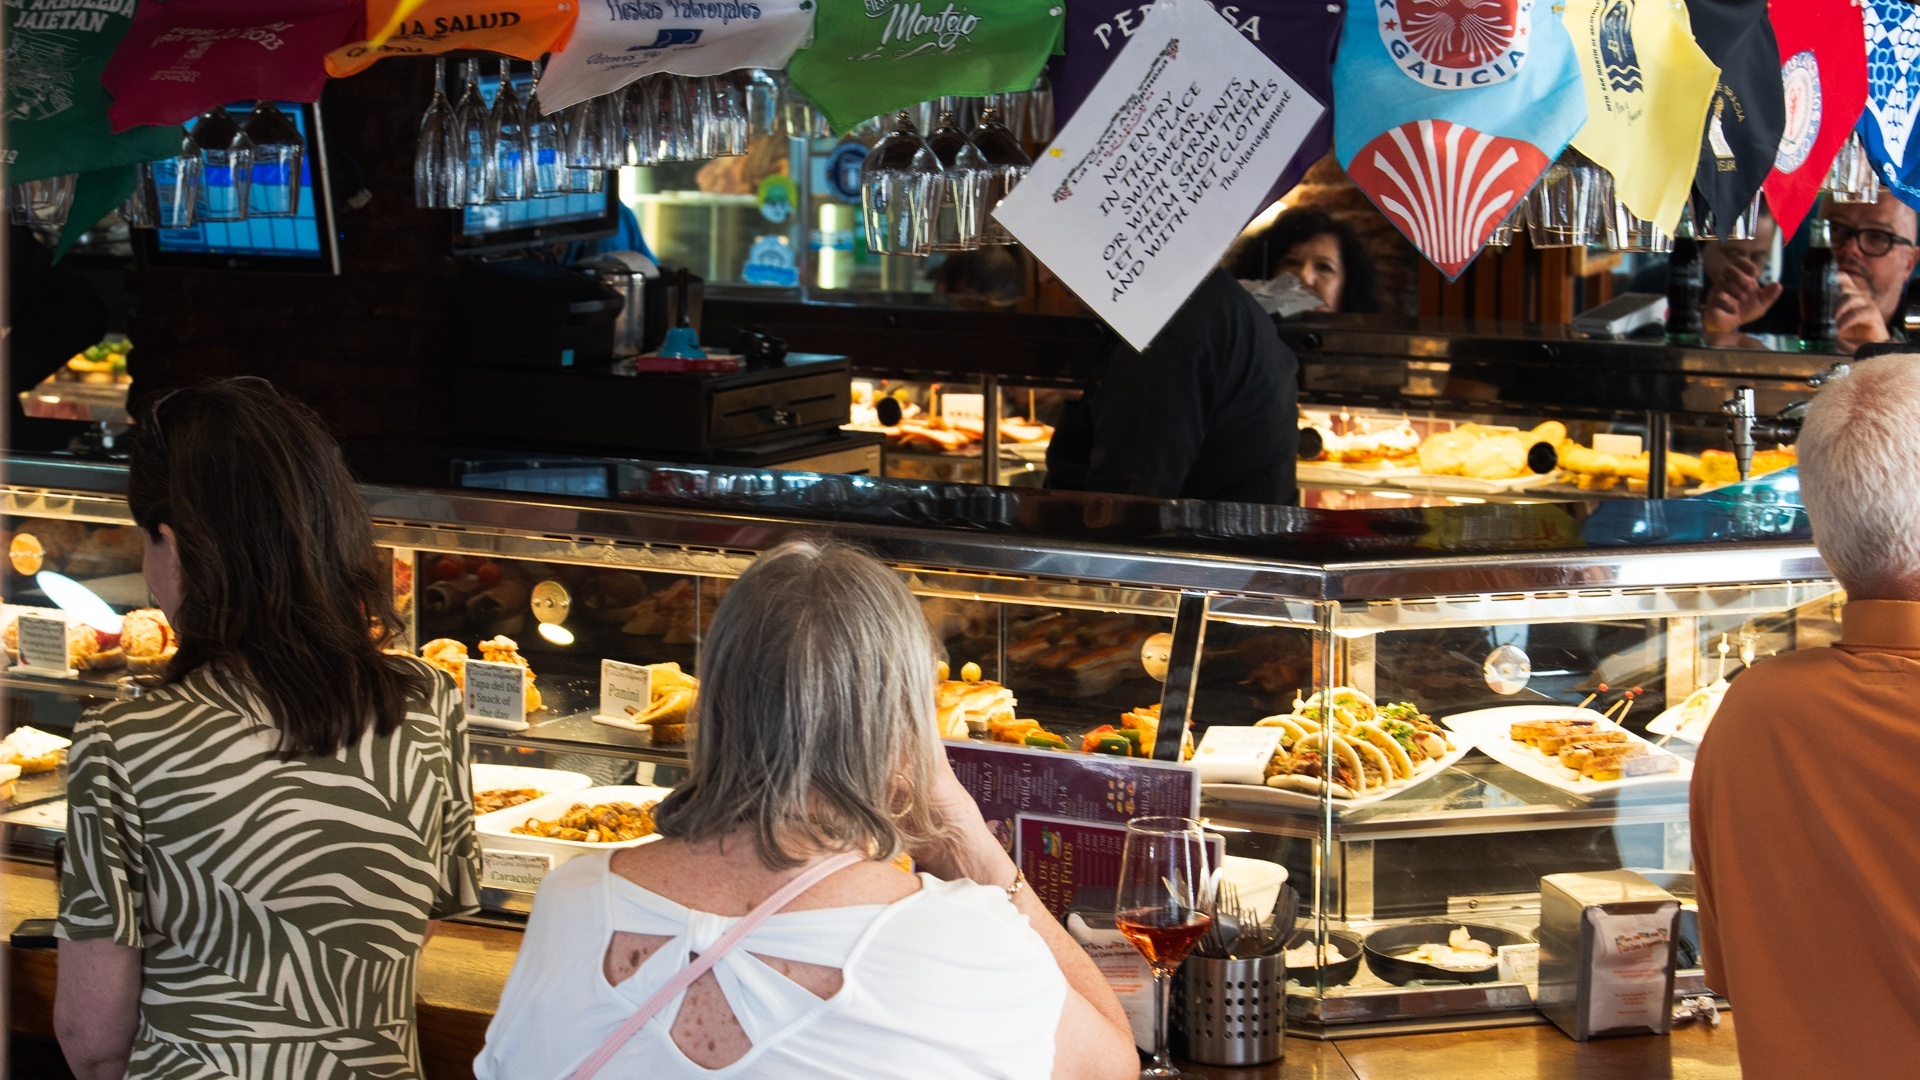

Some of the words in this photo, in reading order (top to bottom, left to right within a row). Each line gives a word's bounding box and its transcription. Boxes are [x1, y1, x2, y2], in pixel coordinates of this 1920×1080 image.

[13, 10, 109, 33] JAIETAN
[434, 11, 521, 36] SALUD
[881, 2, 982, 48] Montejo
[1391, 39, 1525, 87] GALICIA
[1071, 165, 1089, 186] La
[1087, 124, 1119, 166] Cava
[1099, 188, 1122, 216] IN
[1120, 141, 1159, 189] THIS
[1157, 84, 1200, 143] PLACE
[1102, 152, 1129, 187] NO
[1128, 89, 1174, 154] ENTRY
[1219, 167, 1240, 193] The
[1234, 88, 1293, 172] Management
[1102, 230, 1129, 263] OR
[1125, 176, 1171, 231] WITH
[1170, 75, 1243, 178] GARMENTS
[1105, 242, 1134, 282] LET
[1136, 191, 1181, 246] THEM
[1178, 132, 1221, 195] SHOW
[1220, 77, 1262, 134] THEM
[1120, 110, 1206, 217] SWIMWEAR,
[1111, 258, 1146, 304] AND
[1143, 204, 1190, 259] WITH
[1185, 160, 1219, 206] WET
[1219, 76, 1280, 165] CLOTHES
[470, 677, 490, 691] Tapa
[608, 683, 640, 702] Panini
[983, 771, 993, 804] TABLA
[1022, 762, 1032, 774] 11
[1021, 776, 1031, 809] TABLA
[491, 870, 543, 885] Caracoles
[1038, 859, 1048, 881] DE
